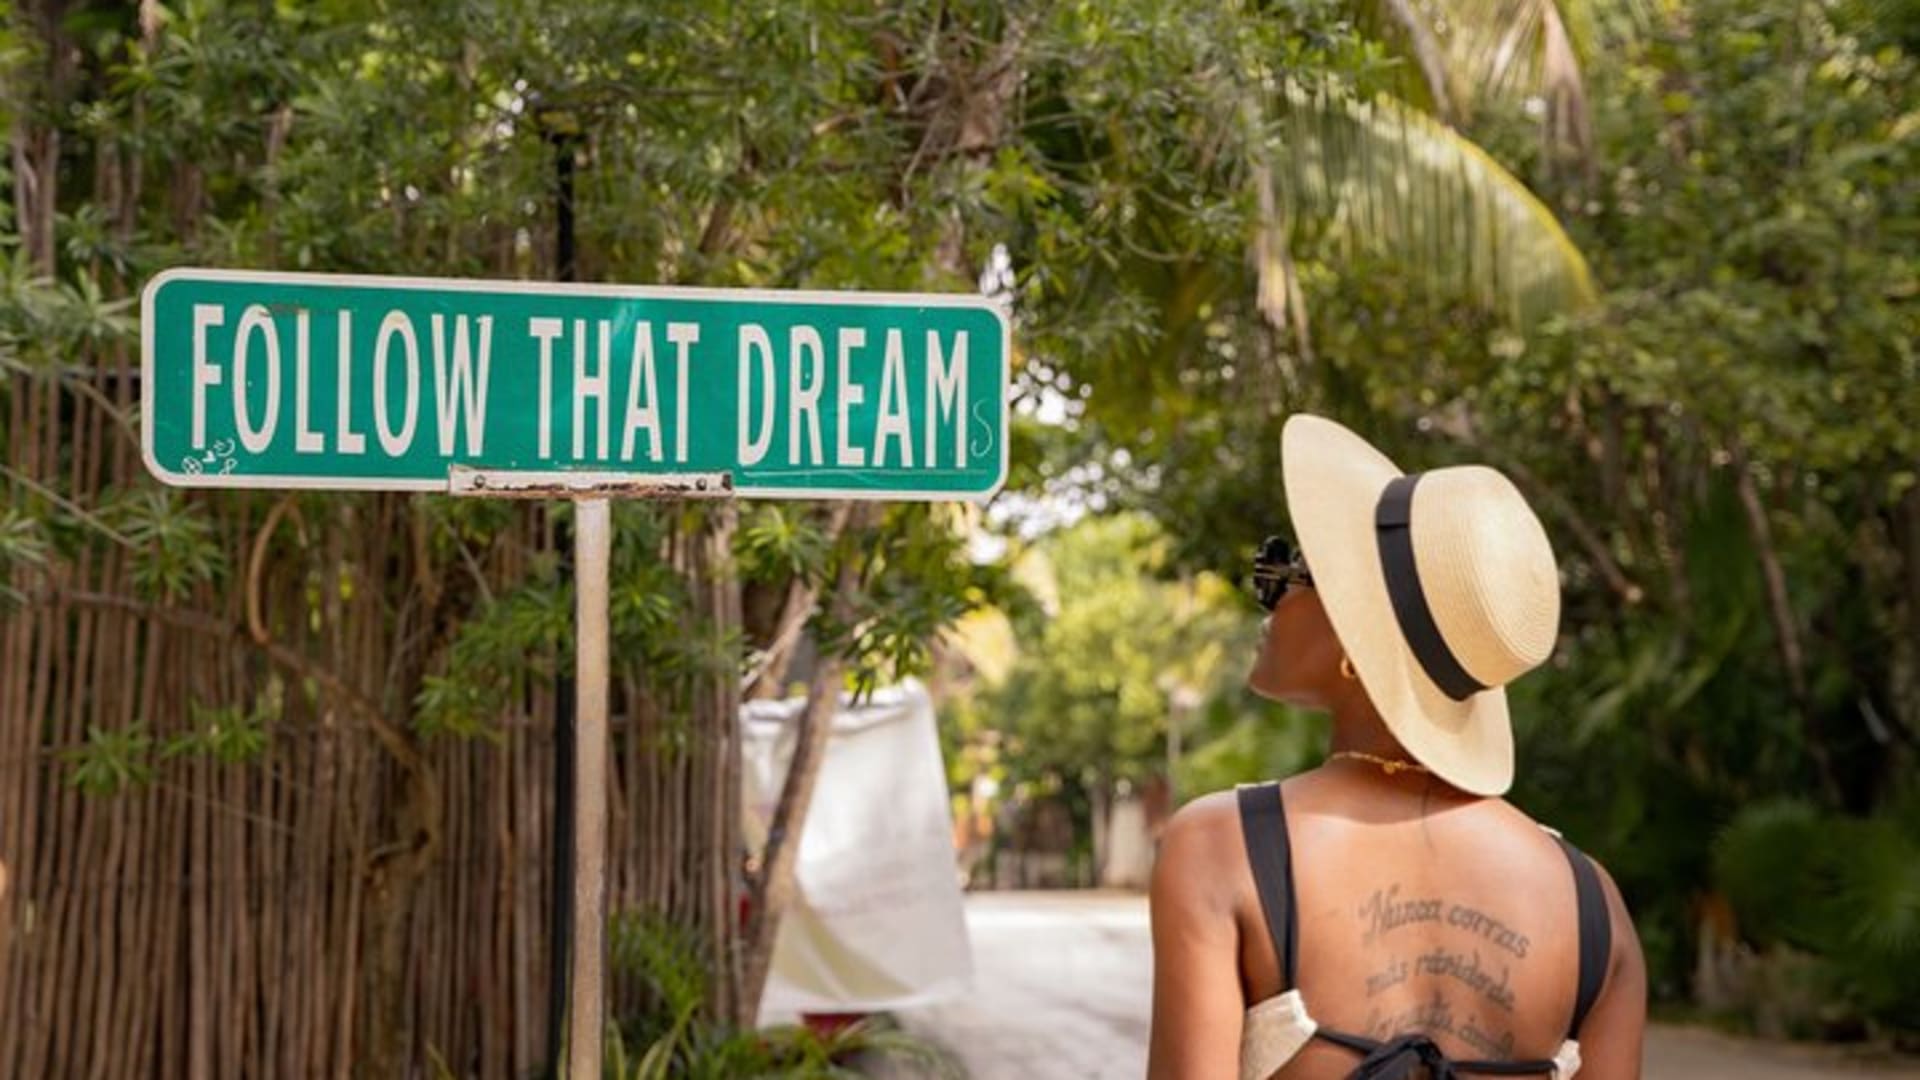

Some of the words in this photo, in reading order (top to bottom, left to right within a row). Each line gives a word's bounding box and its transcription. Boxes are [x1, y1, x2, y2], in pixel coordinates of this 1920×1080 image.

[193, 303, 493, 457] FOLLOW
[529, 317, 701, 462] THAT
[1447, 903, 1530, 959] corras
